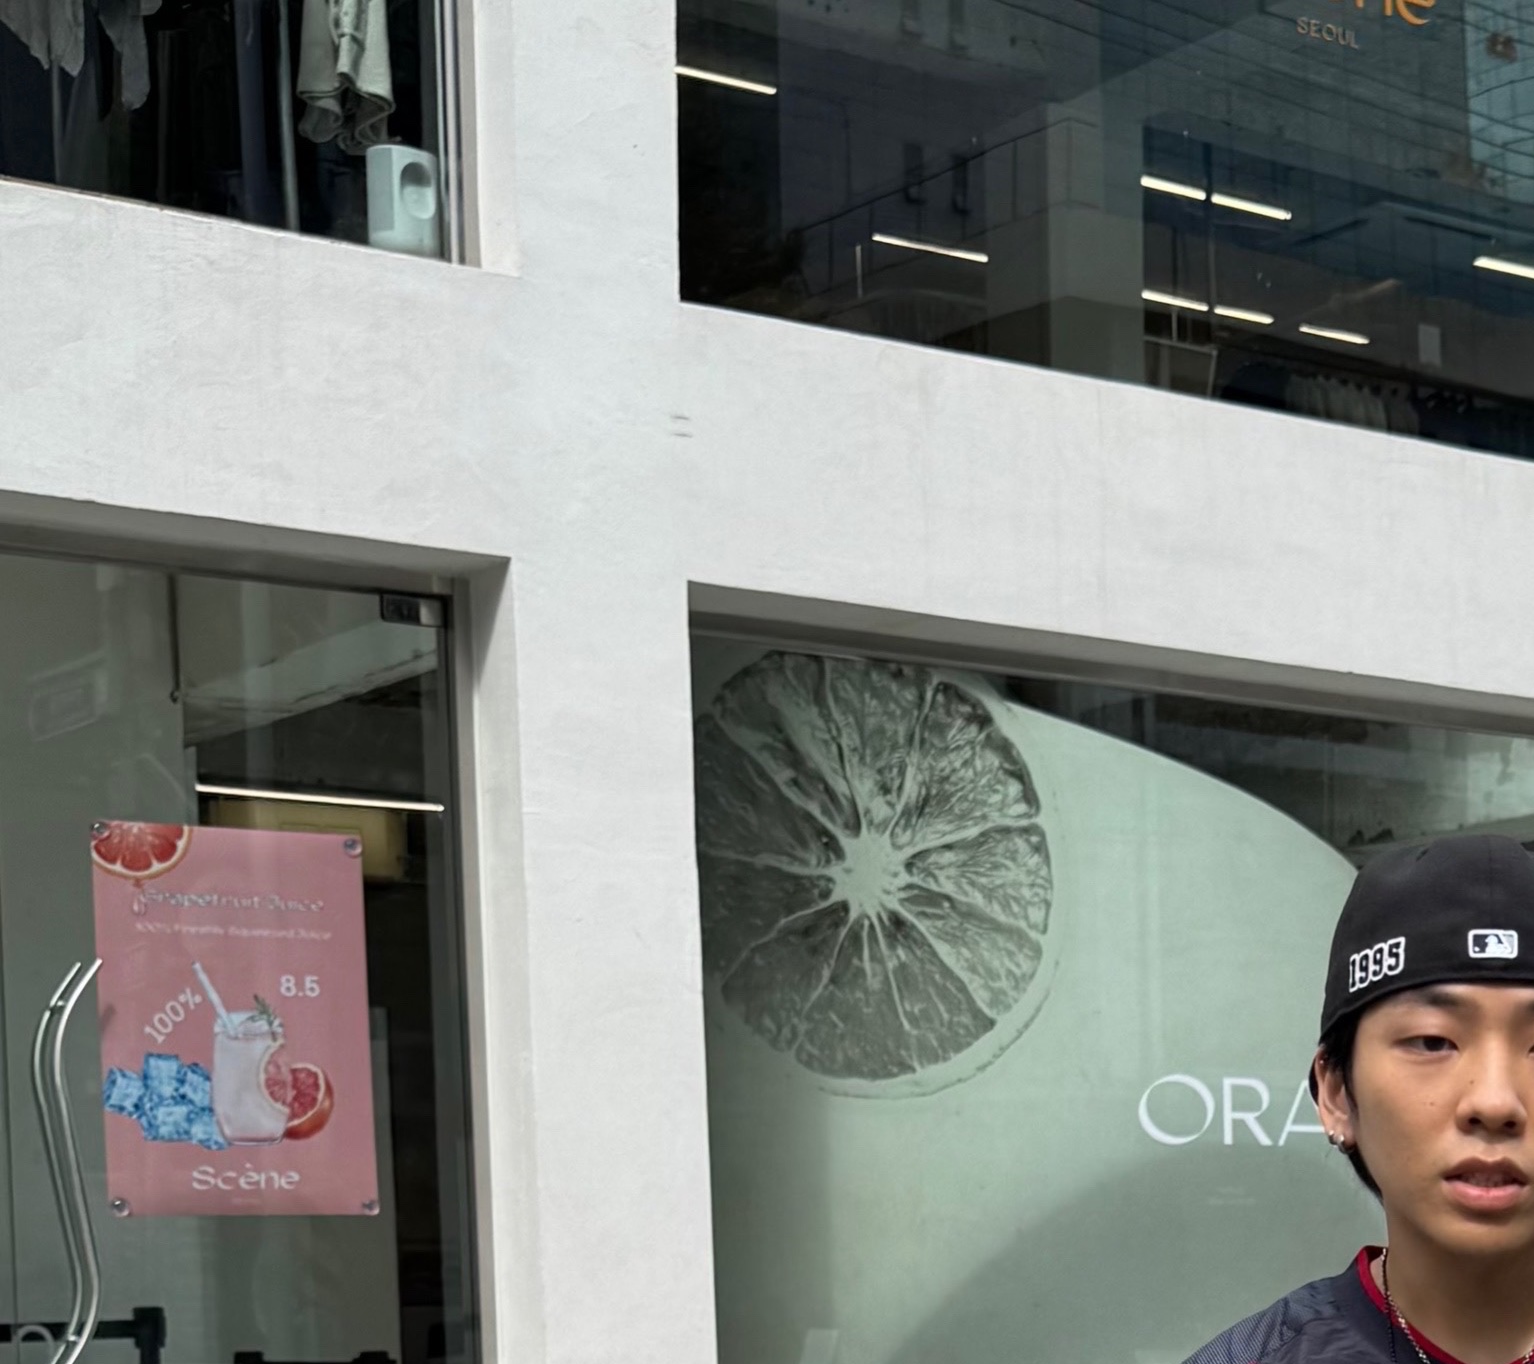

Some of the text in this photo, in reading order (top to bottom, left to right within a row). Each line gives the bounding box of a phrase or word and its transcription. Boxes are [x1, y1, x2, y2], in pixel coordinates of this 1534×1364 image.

[1295, 16, 1359, 50] SEOUL
[1349, 936, 1406, 993] 1995
[280, 974, 320, 998] 8.5
[143, 987, 203, 1045] 100%
[191, 1162, 301, 1190] Scène
